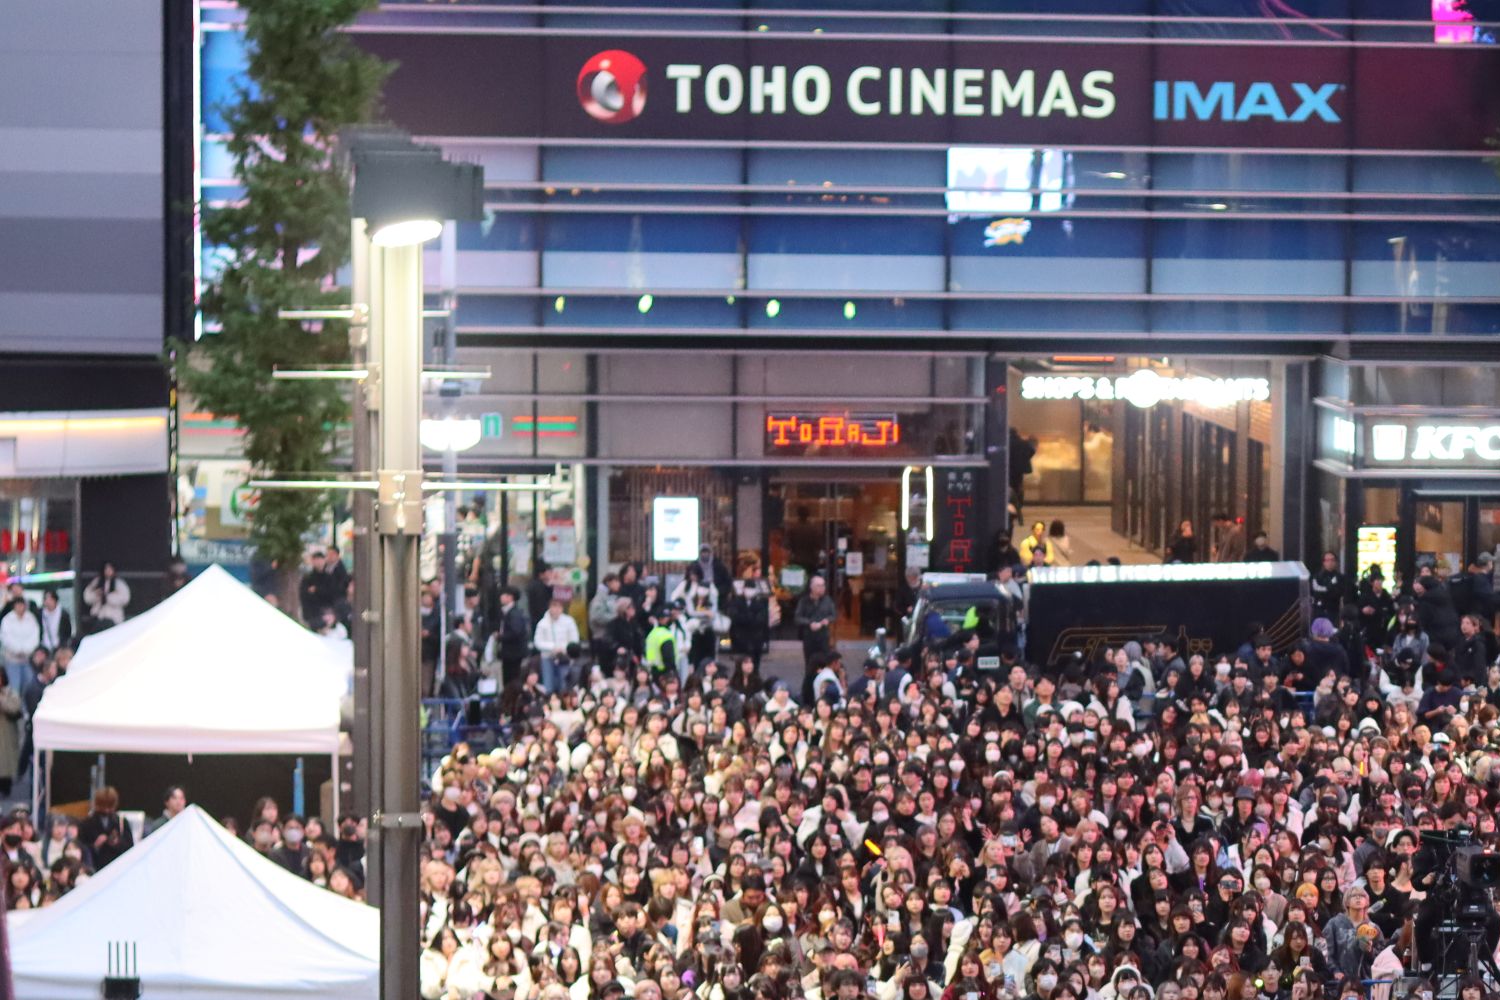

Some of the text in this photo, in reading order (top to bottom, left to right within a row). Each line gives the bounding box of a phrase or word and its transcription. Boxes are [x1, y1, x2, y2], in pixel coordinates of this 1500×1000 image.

[666, 65, 1342, 122] TOHO CINEMAS IMAX
[767, 415, 899, 446] TORAJI
